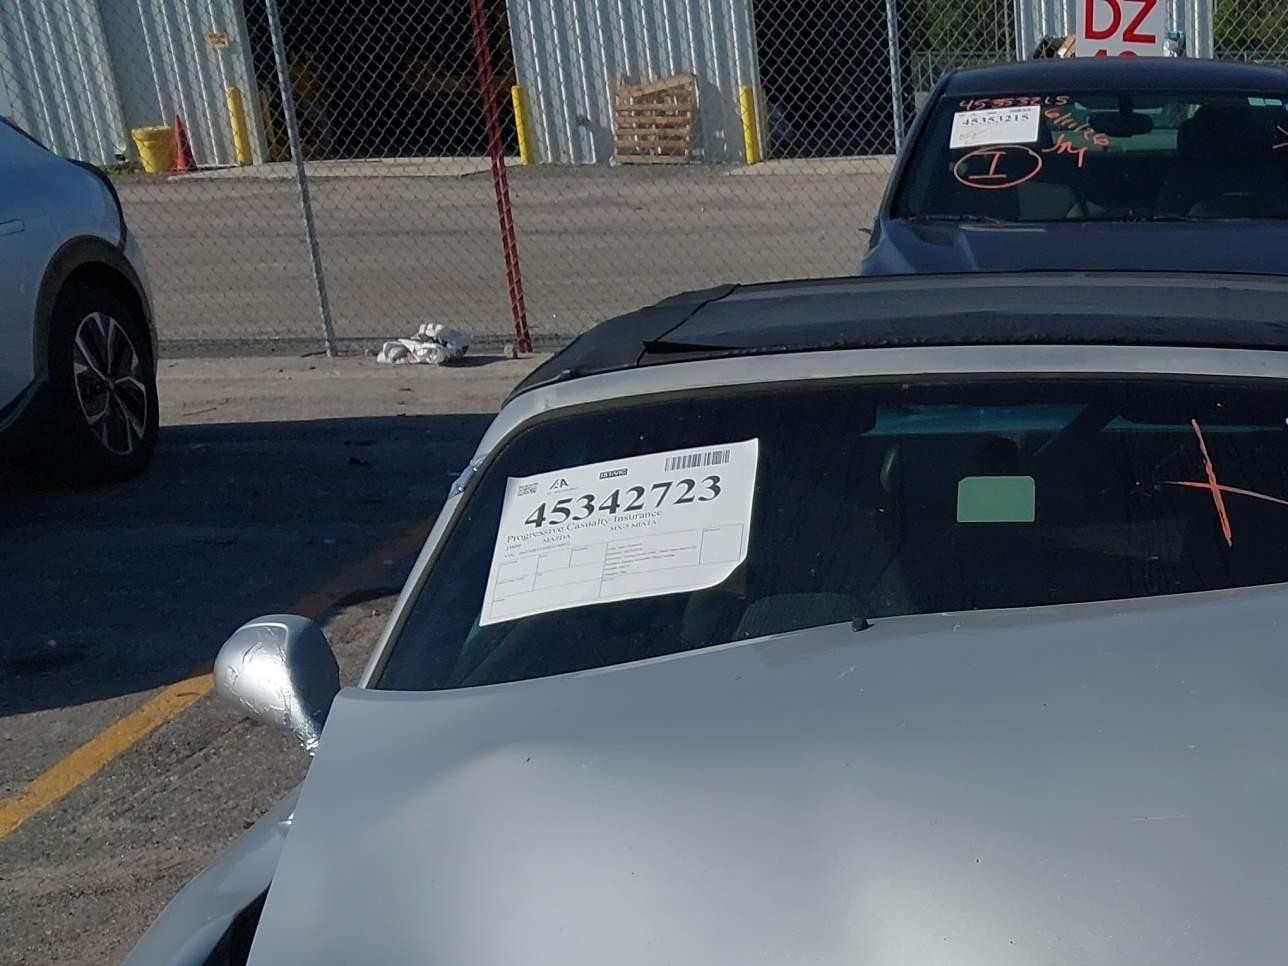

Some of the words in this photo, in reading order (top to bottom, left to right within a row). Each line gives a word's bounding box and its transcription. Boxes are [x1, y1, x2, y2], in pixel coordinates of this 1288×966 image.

[1085, 0, 1157, 43] DZ
[524, 475, 722, 529] 45342723
[506, 525, 564, 544] Progressive
[566, 517, 609, 533] Casualty
[613, 509, 663, 524] Insurance
